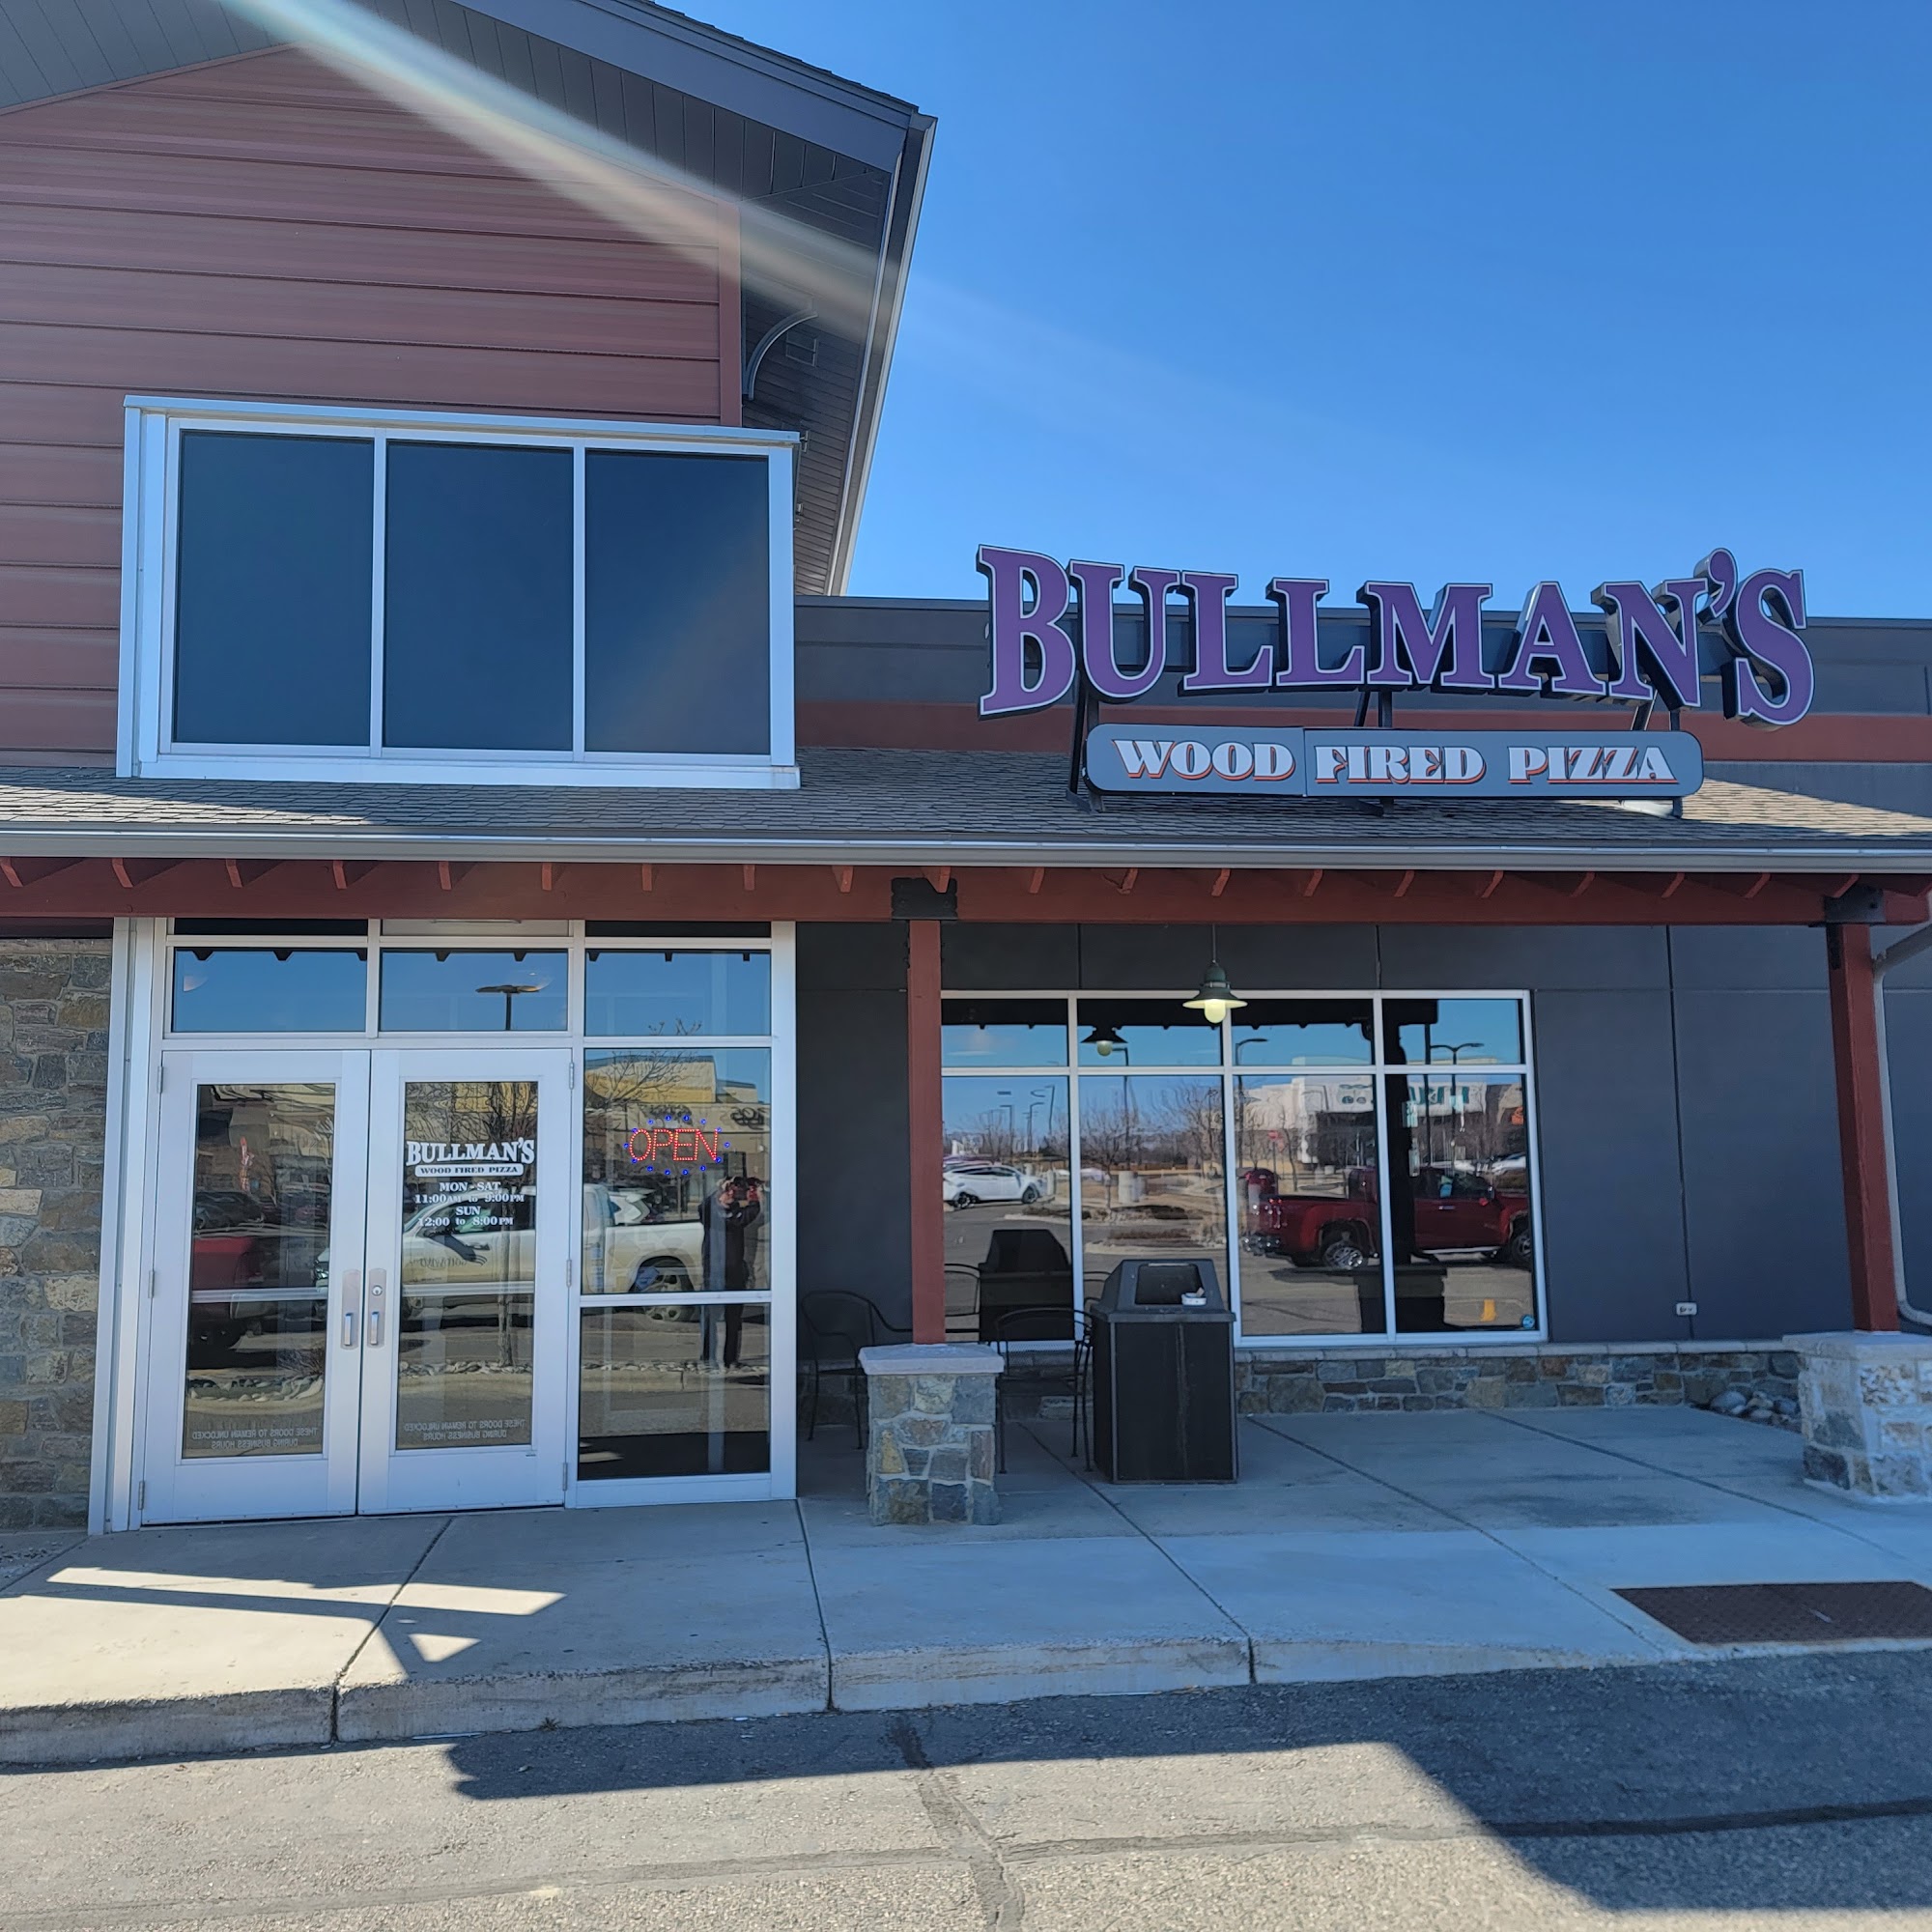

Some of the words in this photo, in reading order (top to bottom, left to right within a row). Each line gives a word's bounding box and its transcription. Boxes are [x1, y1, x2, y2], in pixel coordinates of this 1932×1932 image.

[977, 544, 1815, 726] BULLMAN'S
[1112, 739, 1295, 781] WOOD
[1315, 746, 1487, 783] FIRED
[1507, 746, 1680, 784] PIZZA
[406, 1136, 535, 1166] BULLMAN'S
[629, 1127, 719, 1161] OPEN
[439, 1181, 468, 1192] MON
[476, 1181, 501, 1191] SAT
[468, 1194, 478, 1203] to
[455, 1206, 481, 1216] SUN
[418, 1216, 450, 1227] 12:00
[455, 1217, 466, 1226] to
